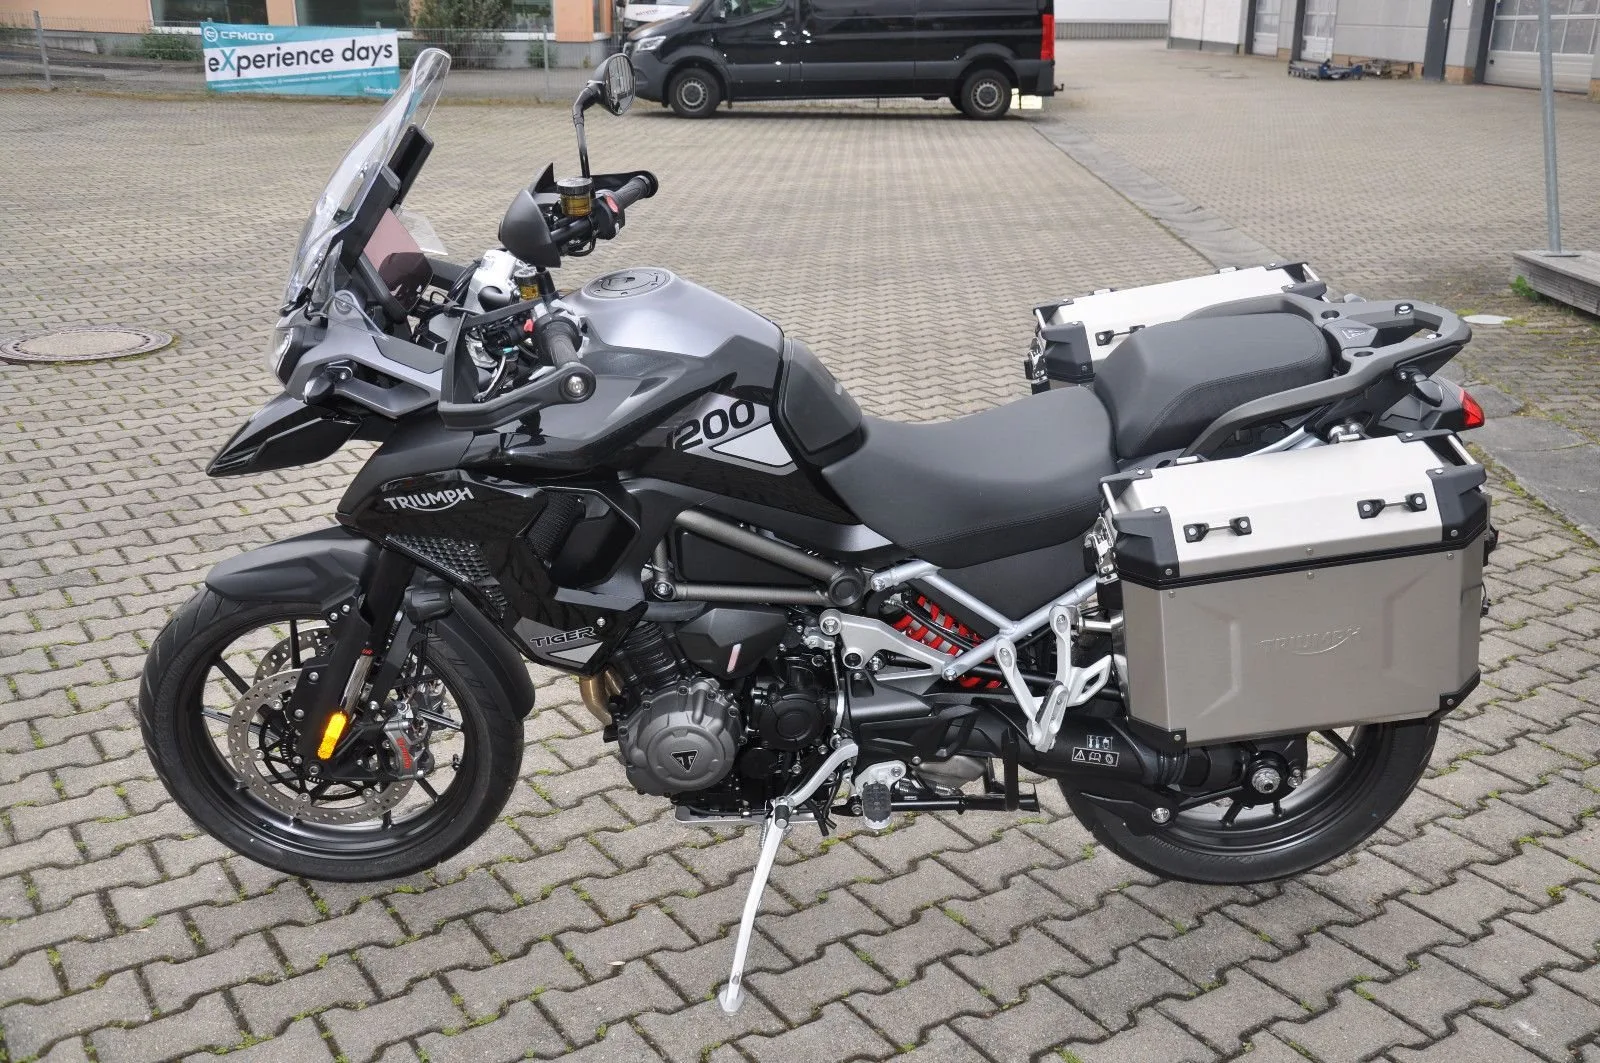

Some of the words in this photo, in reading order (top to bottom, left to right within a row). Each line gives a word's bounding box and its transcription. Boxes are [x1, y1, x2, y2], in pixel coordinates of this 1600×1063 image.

[220, 31, 275, 41] CFMOTO
[208, 47, 334, 77] eXperience
[341, 39, 393, 67] days
[383, 486, 475, 511] TRIUMPH
[530, 626, 597, 648] TIGER
